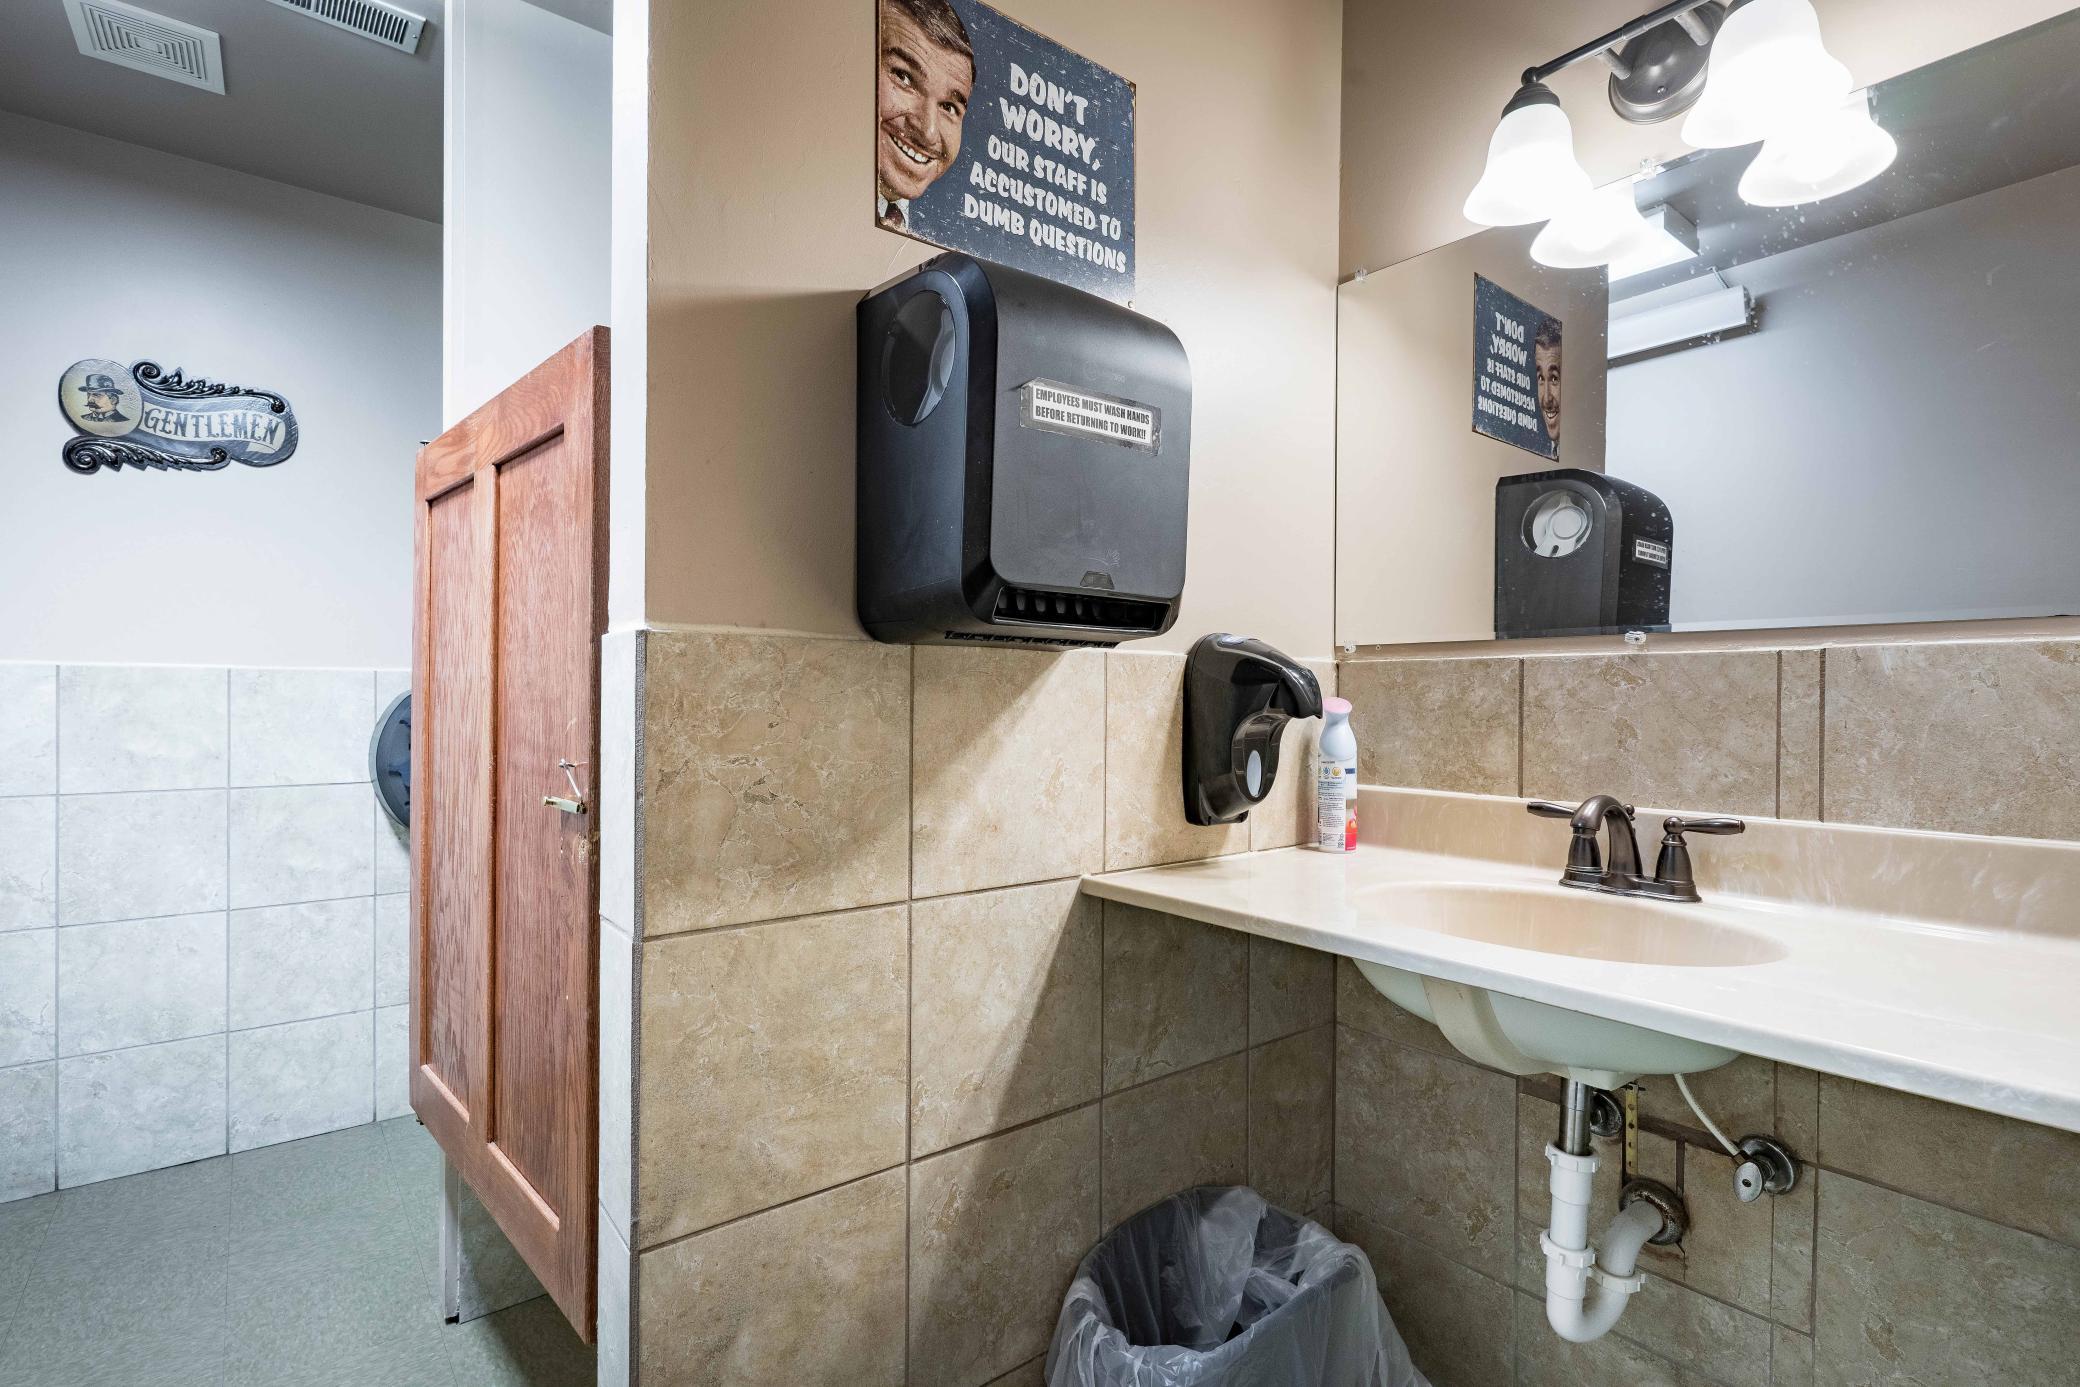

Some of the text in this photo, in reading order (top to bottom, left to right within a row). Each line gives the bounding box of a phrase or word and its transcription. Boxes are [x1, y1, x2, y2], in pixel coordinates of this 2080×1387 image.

[1010, 62, 1088, 126] DON'T
[999, 97, 1101, 171] WORRY,
[969, 161, 1121, 241] ACCUSTOMED TO
[987, 134, 1108, 205] OUR STAFF IS
[964, 193, 1127, 274] DUMB QUESTIONS
[143, 407, 280, 446] GENTLEMEN
[1035, 387, 1150, 425] EMPLOYEES MUST WASH HANDS
[1035, 405, 1146, 440] BEFORE RETURNING TO WORK!!
